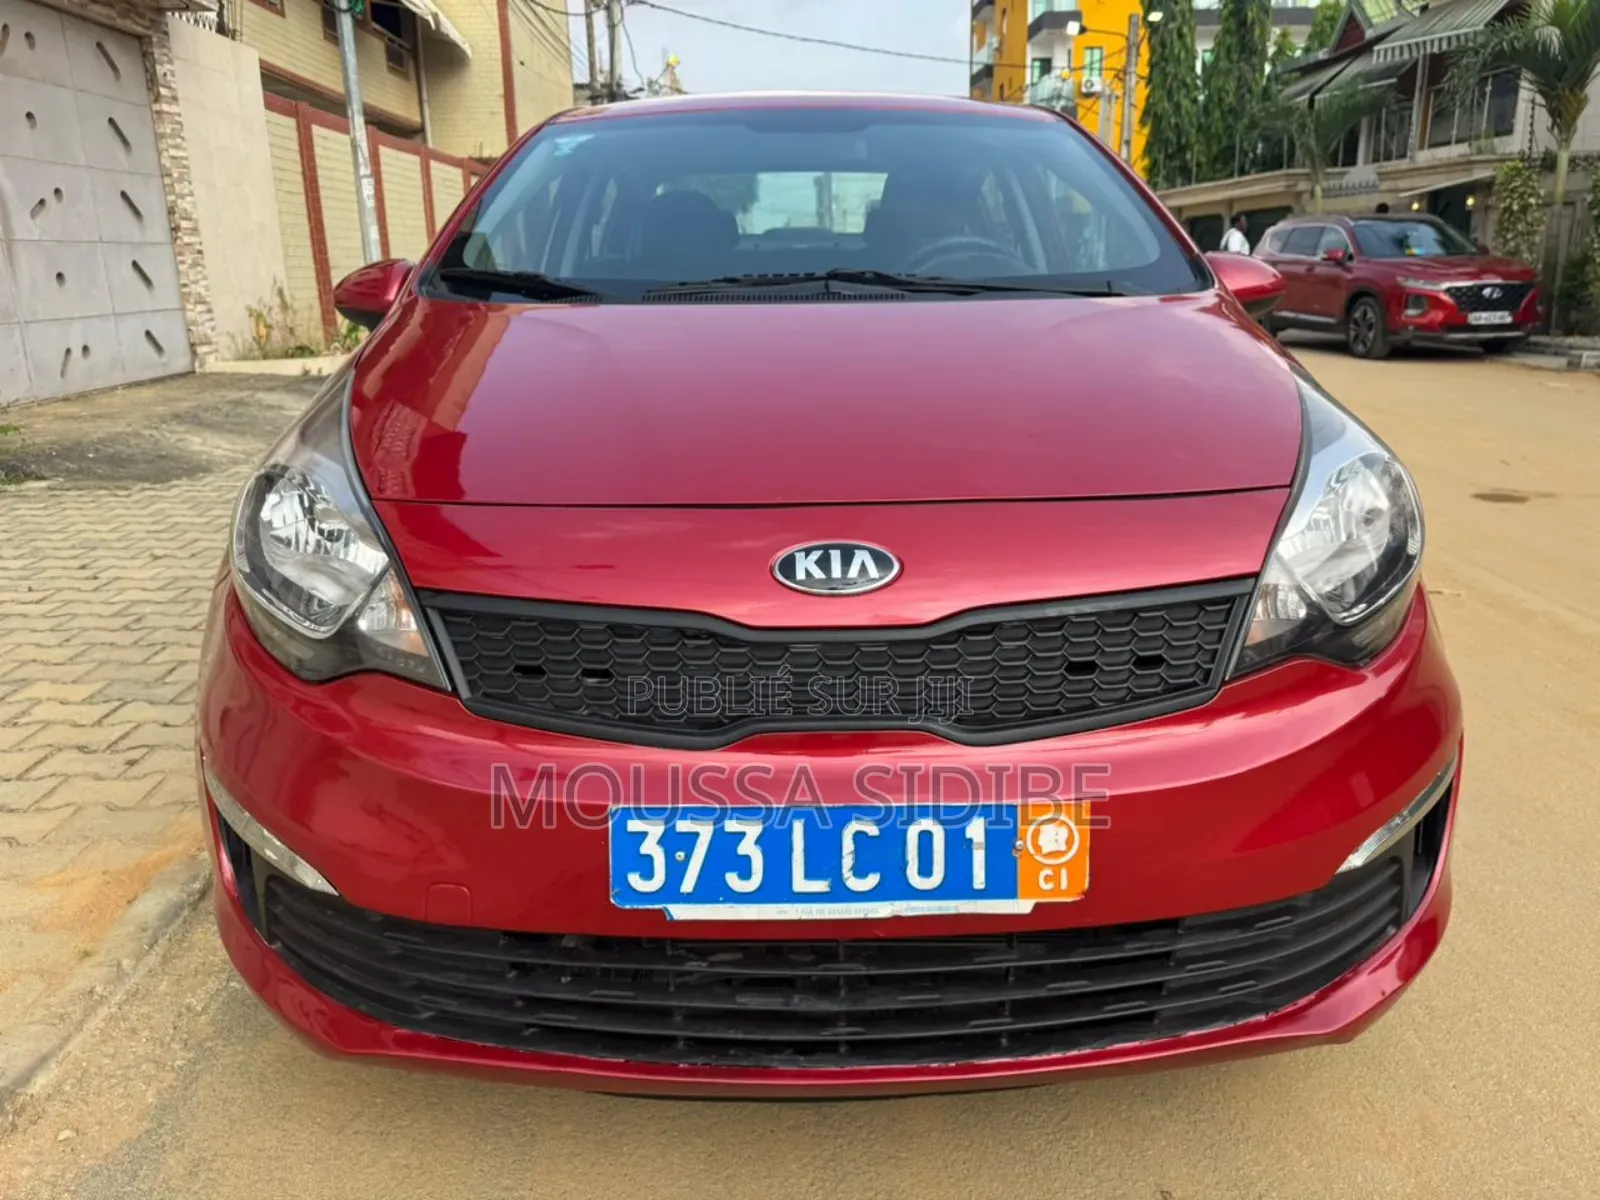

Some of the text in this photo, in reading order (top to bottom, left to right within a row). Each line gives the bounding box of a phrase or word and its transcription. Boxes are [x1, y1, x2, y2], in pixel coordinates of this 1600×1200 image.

[794, 549, 880, 580] KIA
[626, 816, 986, 893] 373 LC 01
[1038, 867, 1069, 891] CI
